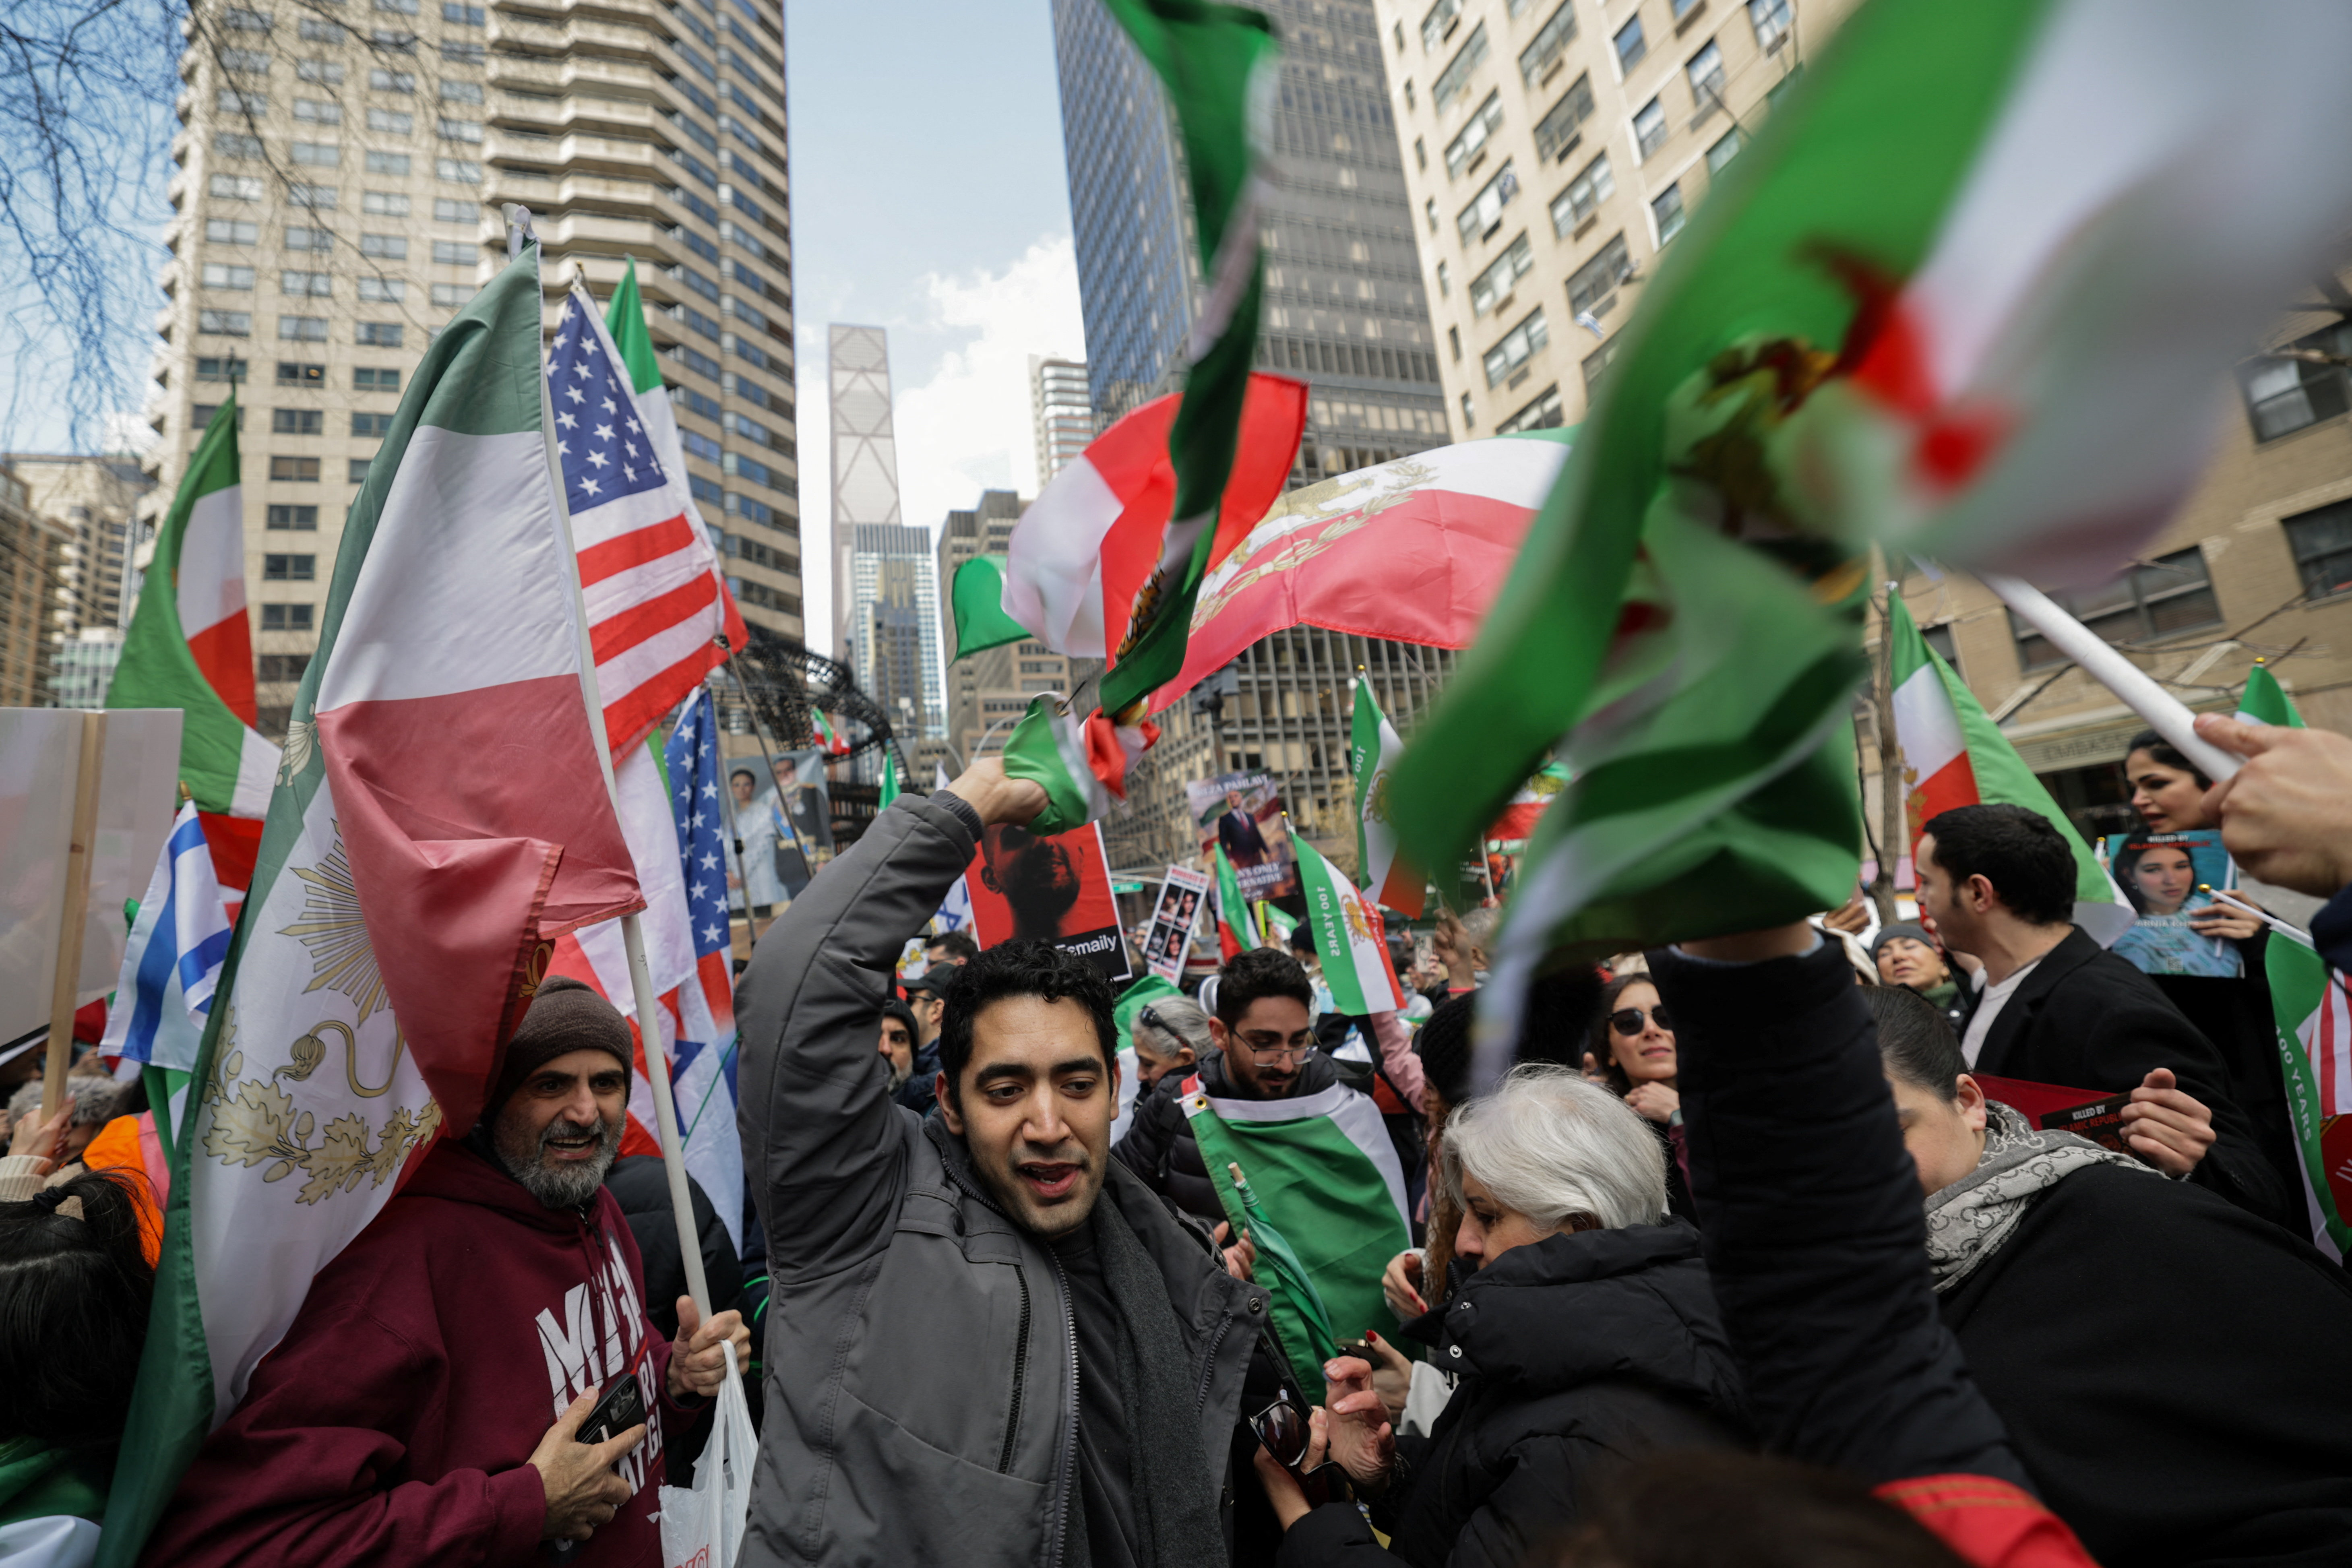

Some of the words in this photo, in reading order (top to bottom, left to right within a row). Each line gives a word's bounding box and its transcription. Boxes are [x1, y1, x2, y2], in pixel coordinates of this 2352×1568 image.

[1224, 774, 1268, 791] PAHLAVI
[2147, 835, 2176, 843] KILLED
[2167, 840, 2211, 848] REPUBLIC
[1252, 861, 1280, 876] ONLY
[1055, 934, 1116, 956] smaily
[2072, 1107, 2096, 1120] KILLED
[2096, 1105, 2105, 1114] BY
[2292, 1069, 2311, 1141] YEARS
[2089, 1112, 2122, 1128] REPUBLI
